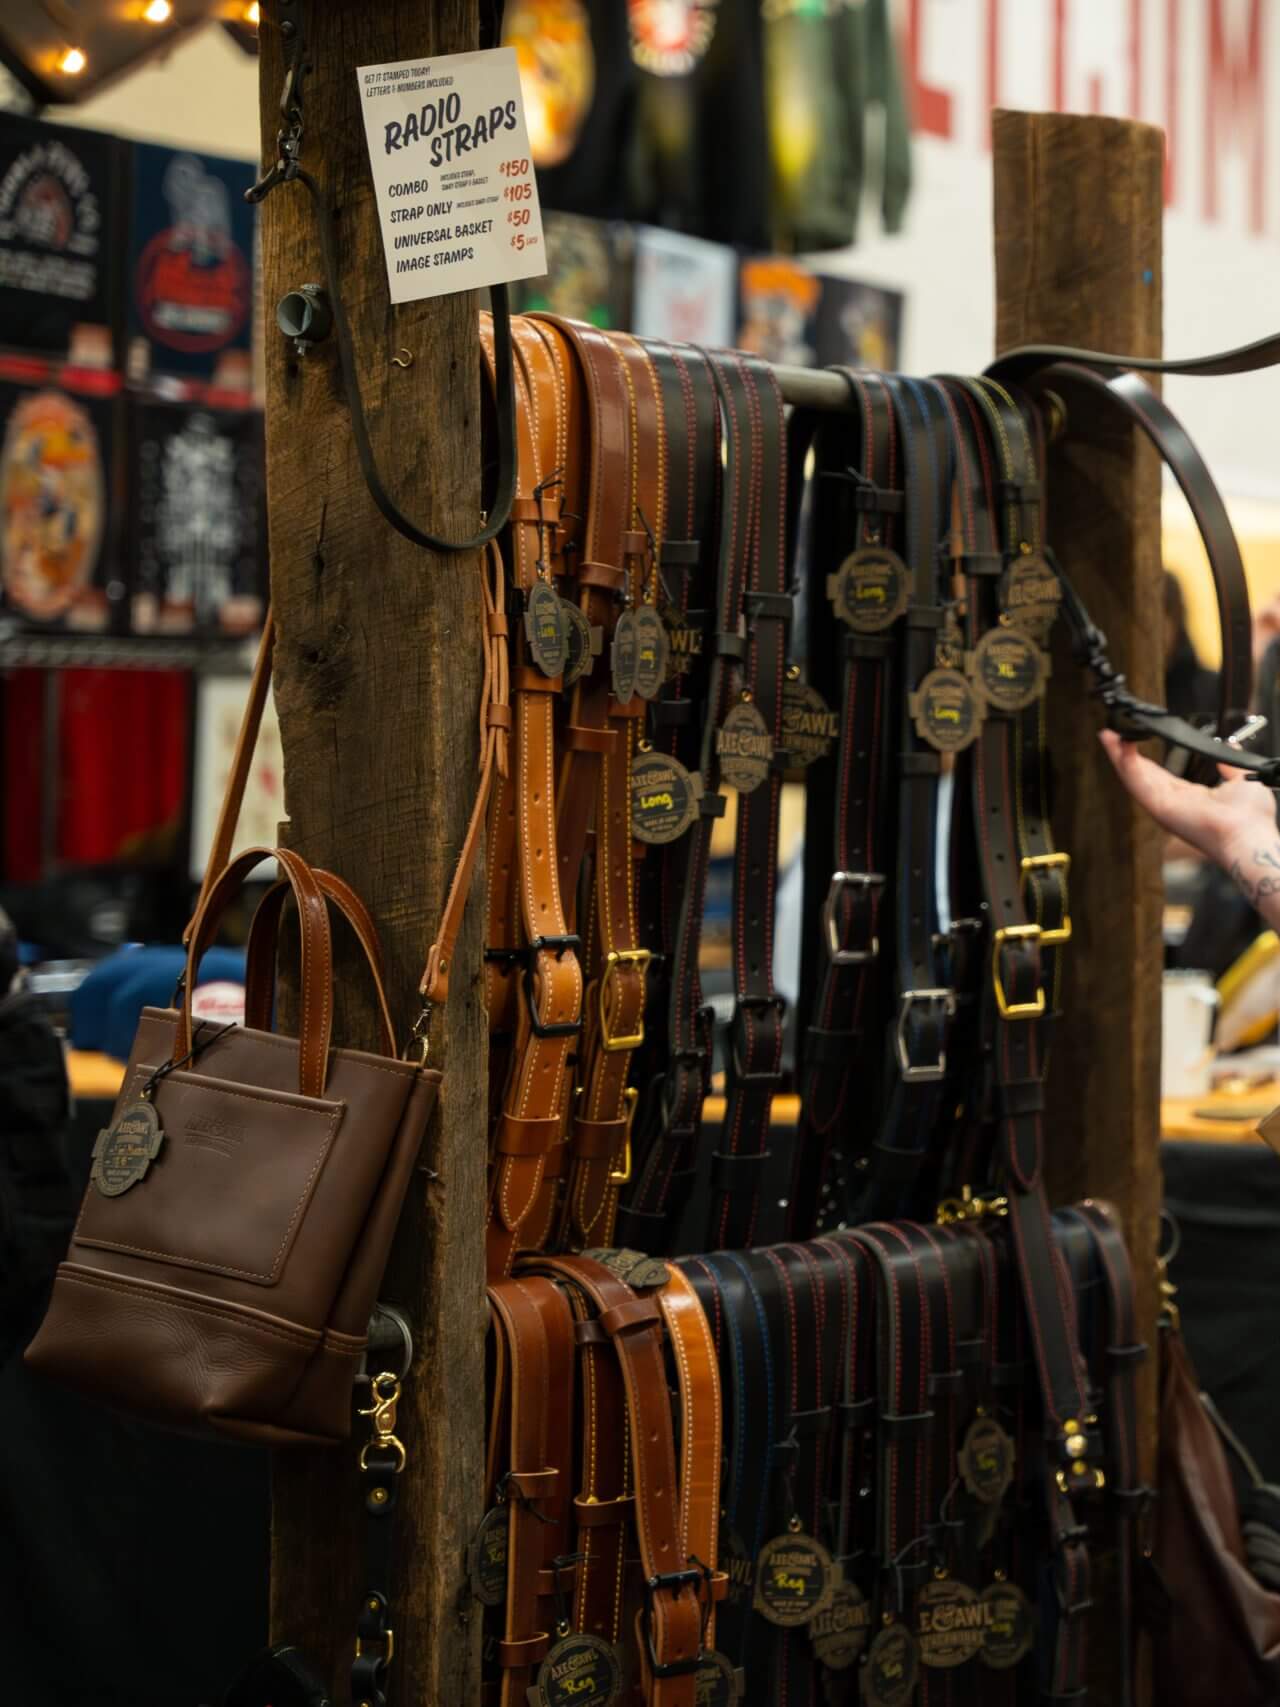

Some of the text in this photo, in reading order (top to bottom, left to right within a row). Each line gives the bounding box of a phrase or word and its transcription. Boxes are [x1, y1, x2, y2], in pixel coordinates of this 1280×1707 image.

[364, 74, 376, 84] GET
[383, 69, 410, 82] STAMPED
[366, 84, 391, 97] LETTERS
[397, 80, 426, 93] NUMBERS
[426, 76, 454, 88] INCLUDED
[384, 92, 461, 155] RADIO
[430, 100, 516, 167] STRAPS
[388, 158, 529, 198] COMBO $150
[504, 183, 532, 201] $105
[390, 200, 453, 223] STRAP ONLY
[394, 209, 530, 250] UNIVERSAL BASKET $50
[396, 255, 431, 274] IMAGE
[433, 247, 474, 266] STAMPS
[511, 234, 525, 251] $5
[641, 793, 673, 810] Long
